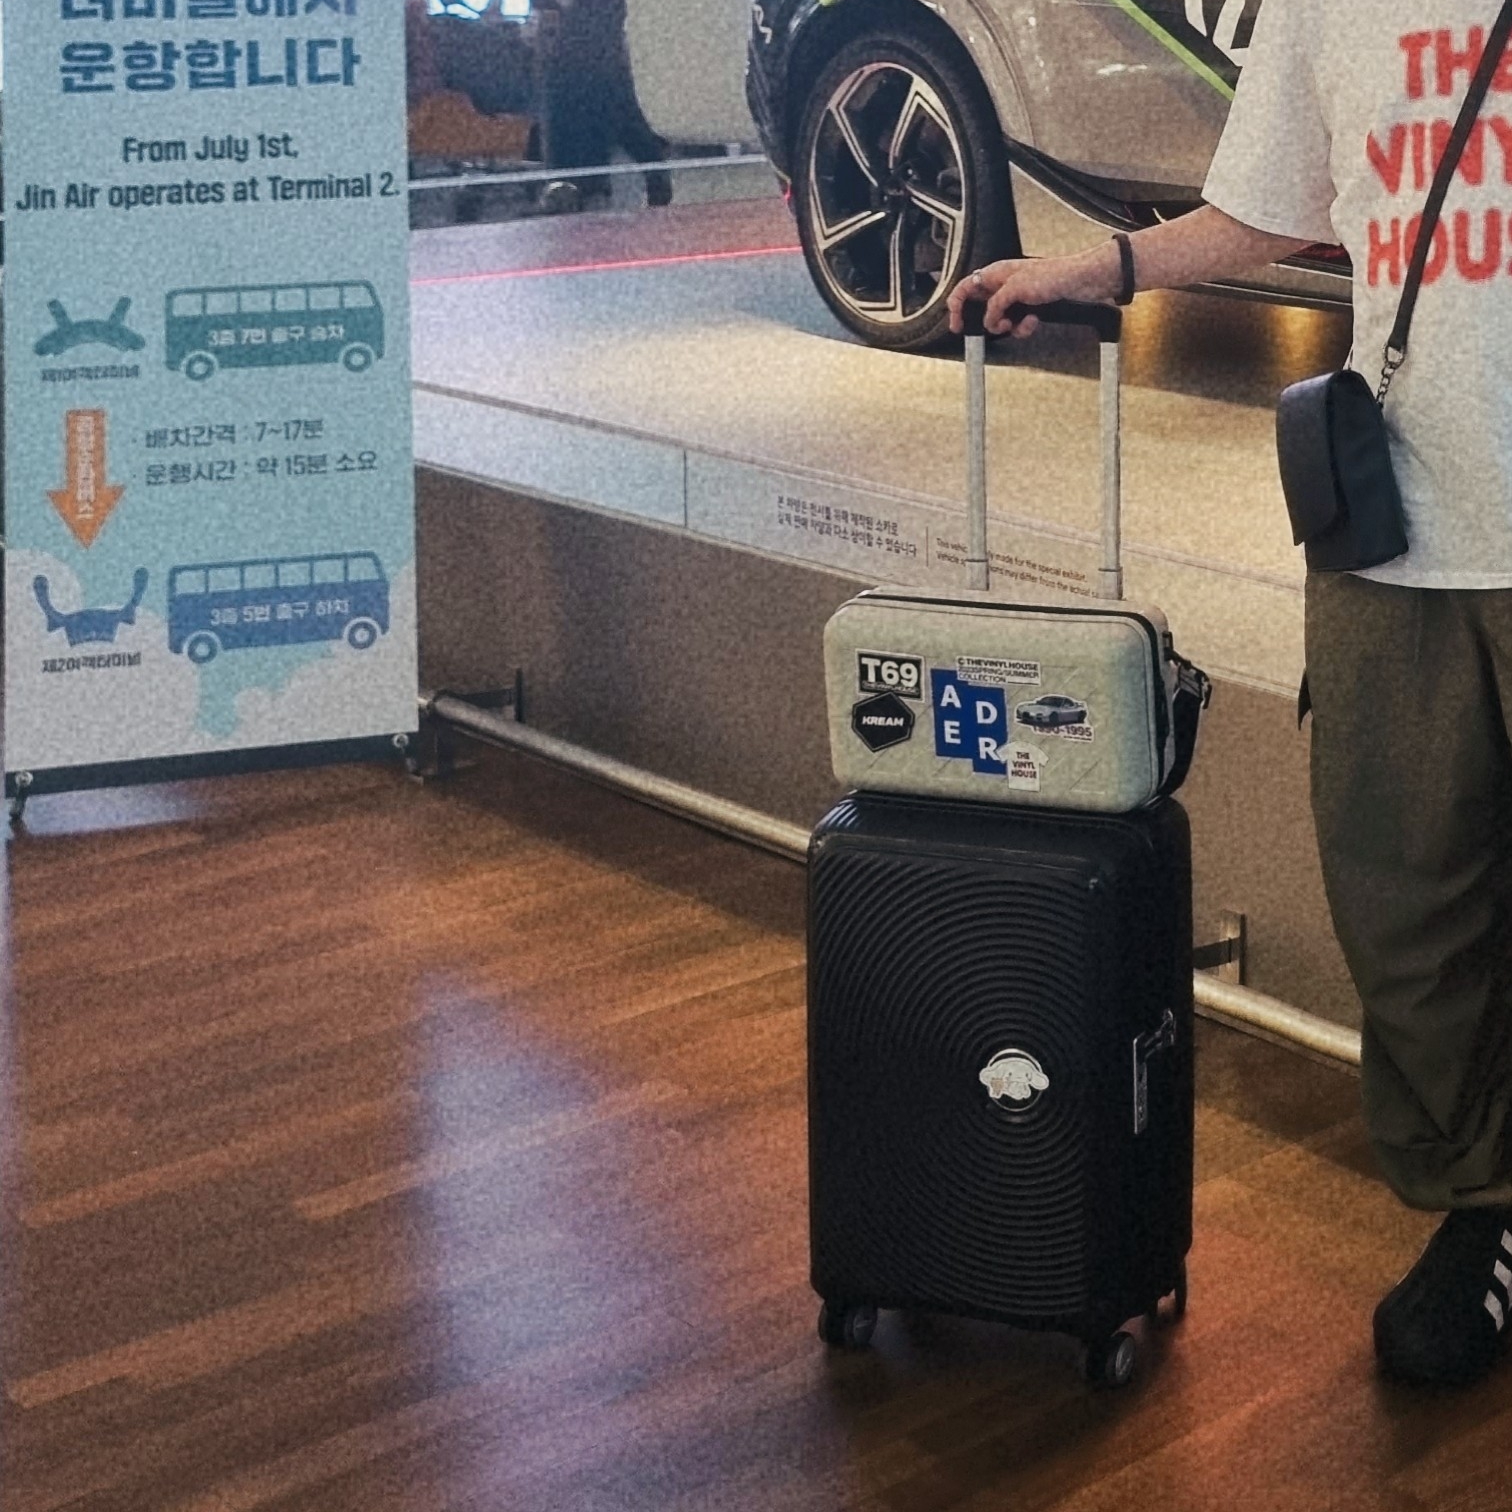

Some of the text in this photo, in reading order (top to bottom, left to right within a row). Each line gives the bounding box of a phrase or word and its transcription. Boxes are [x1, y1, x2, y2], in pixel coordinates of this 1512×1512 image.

[59, 37, 361, 93] 운항합니다
[122, 136, 187, 163] From
[194, 133, 249, 163] July
[15, 184, 57, 211] Jin
[65, 183, 101, 209] Air
[108, 178, 225, 210] operates
[233, 176, 260, 202] at
[267, 173, 372, 201] Terminal
[145, 424, 236, 449] 배차간격
[146, 460, 237, 486] 운행시간
[256, 456, 278, 476] 약
[285, 454, 328, 476] 15분
[334, 450, 377, 473] 소요
[861, 657, 919, 687] T69
[862, 715, 904, 727] KREAM
